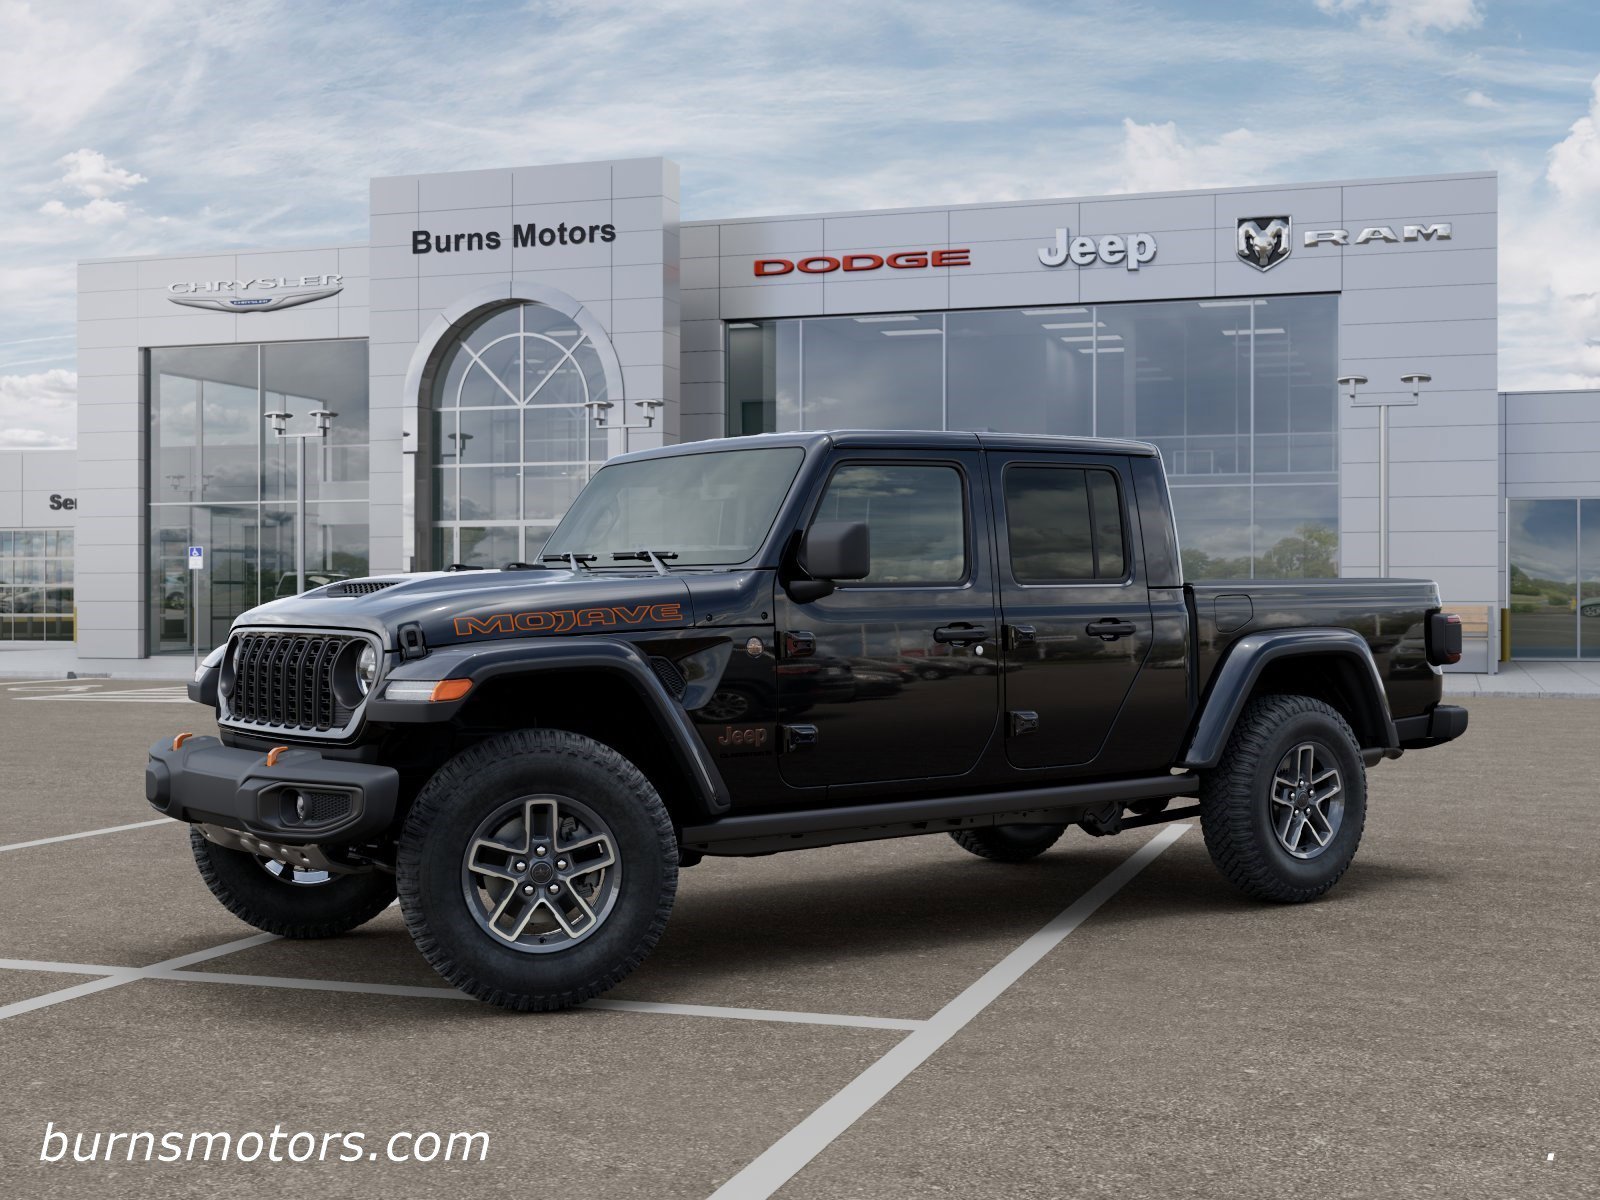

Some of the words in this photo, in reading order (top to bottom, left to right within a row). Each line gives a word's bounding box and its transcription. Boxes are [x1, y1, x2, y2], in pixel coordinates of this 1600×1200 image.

[412, 230, 501, 254] Burns
[513, 222, 617, 248] Motors
[1304, 222, 1452, 247] RAM
[1038, 227, 1157, 271] Jeep
[754, 249, 971, 276] DODGE
[168, 274, 343, 293] CHRYSLER
[49, 494, 77, 511] Se
[453, 603, 683, 636] MOJAVE
[719, 727, 767, 748] Jeep
